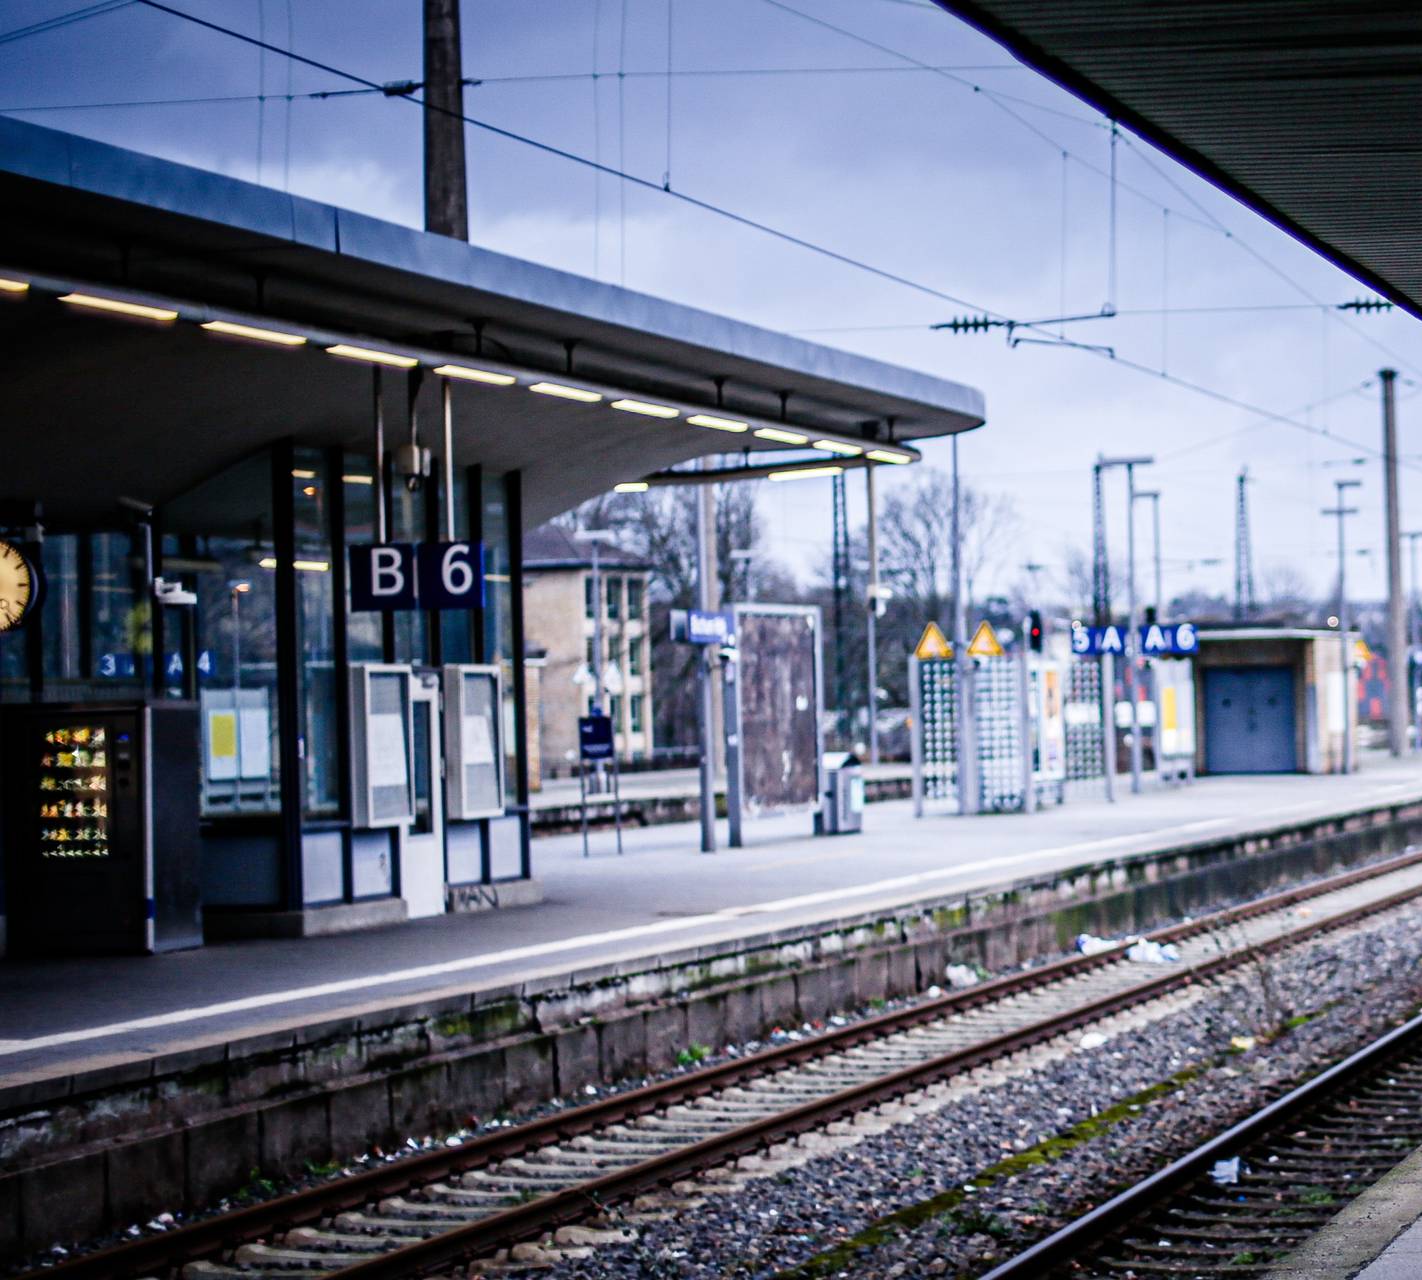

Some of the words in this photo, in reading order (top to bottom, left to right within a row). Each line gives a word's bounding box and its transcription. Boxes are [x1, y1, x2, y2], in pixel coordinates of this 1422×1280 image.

[371, 547, 405, 596] B
[442, 543, 473, 595] 6
[1073, 625, 1090, 653] 5
[1101, 625, 1122, 652] A
[1145, 624, 1166, 651] A
[1176, 623, 1195, 650] 6
[101, 653, 117, 677] 3
